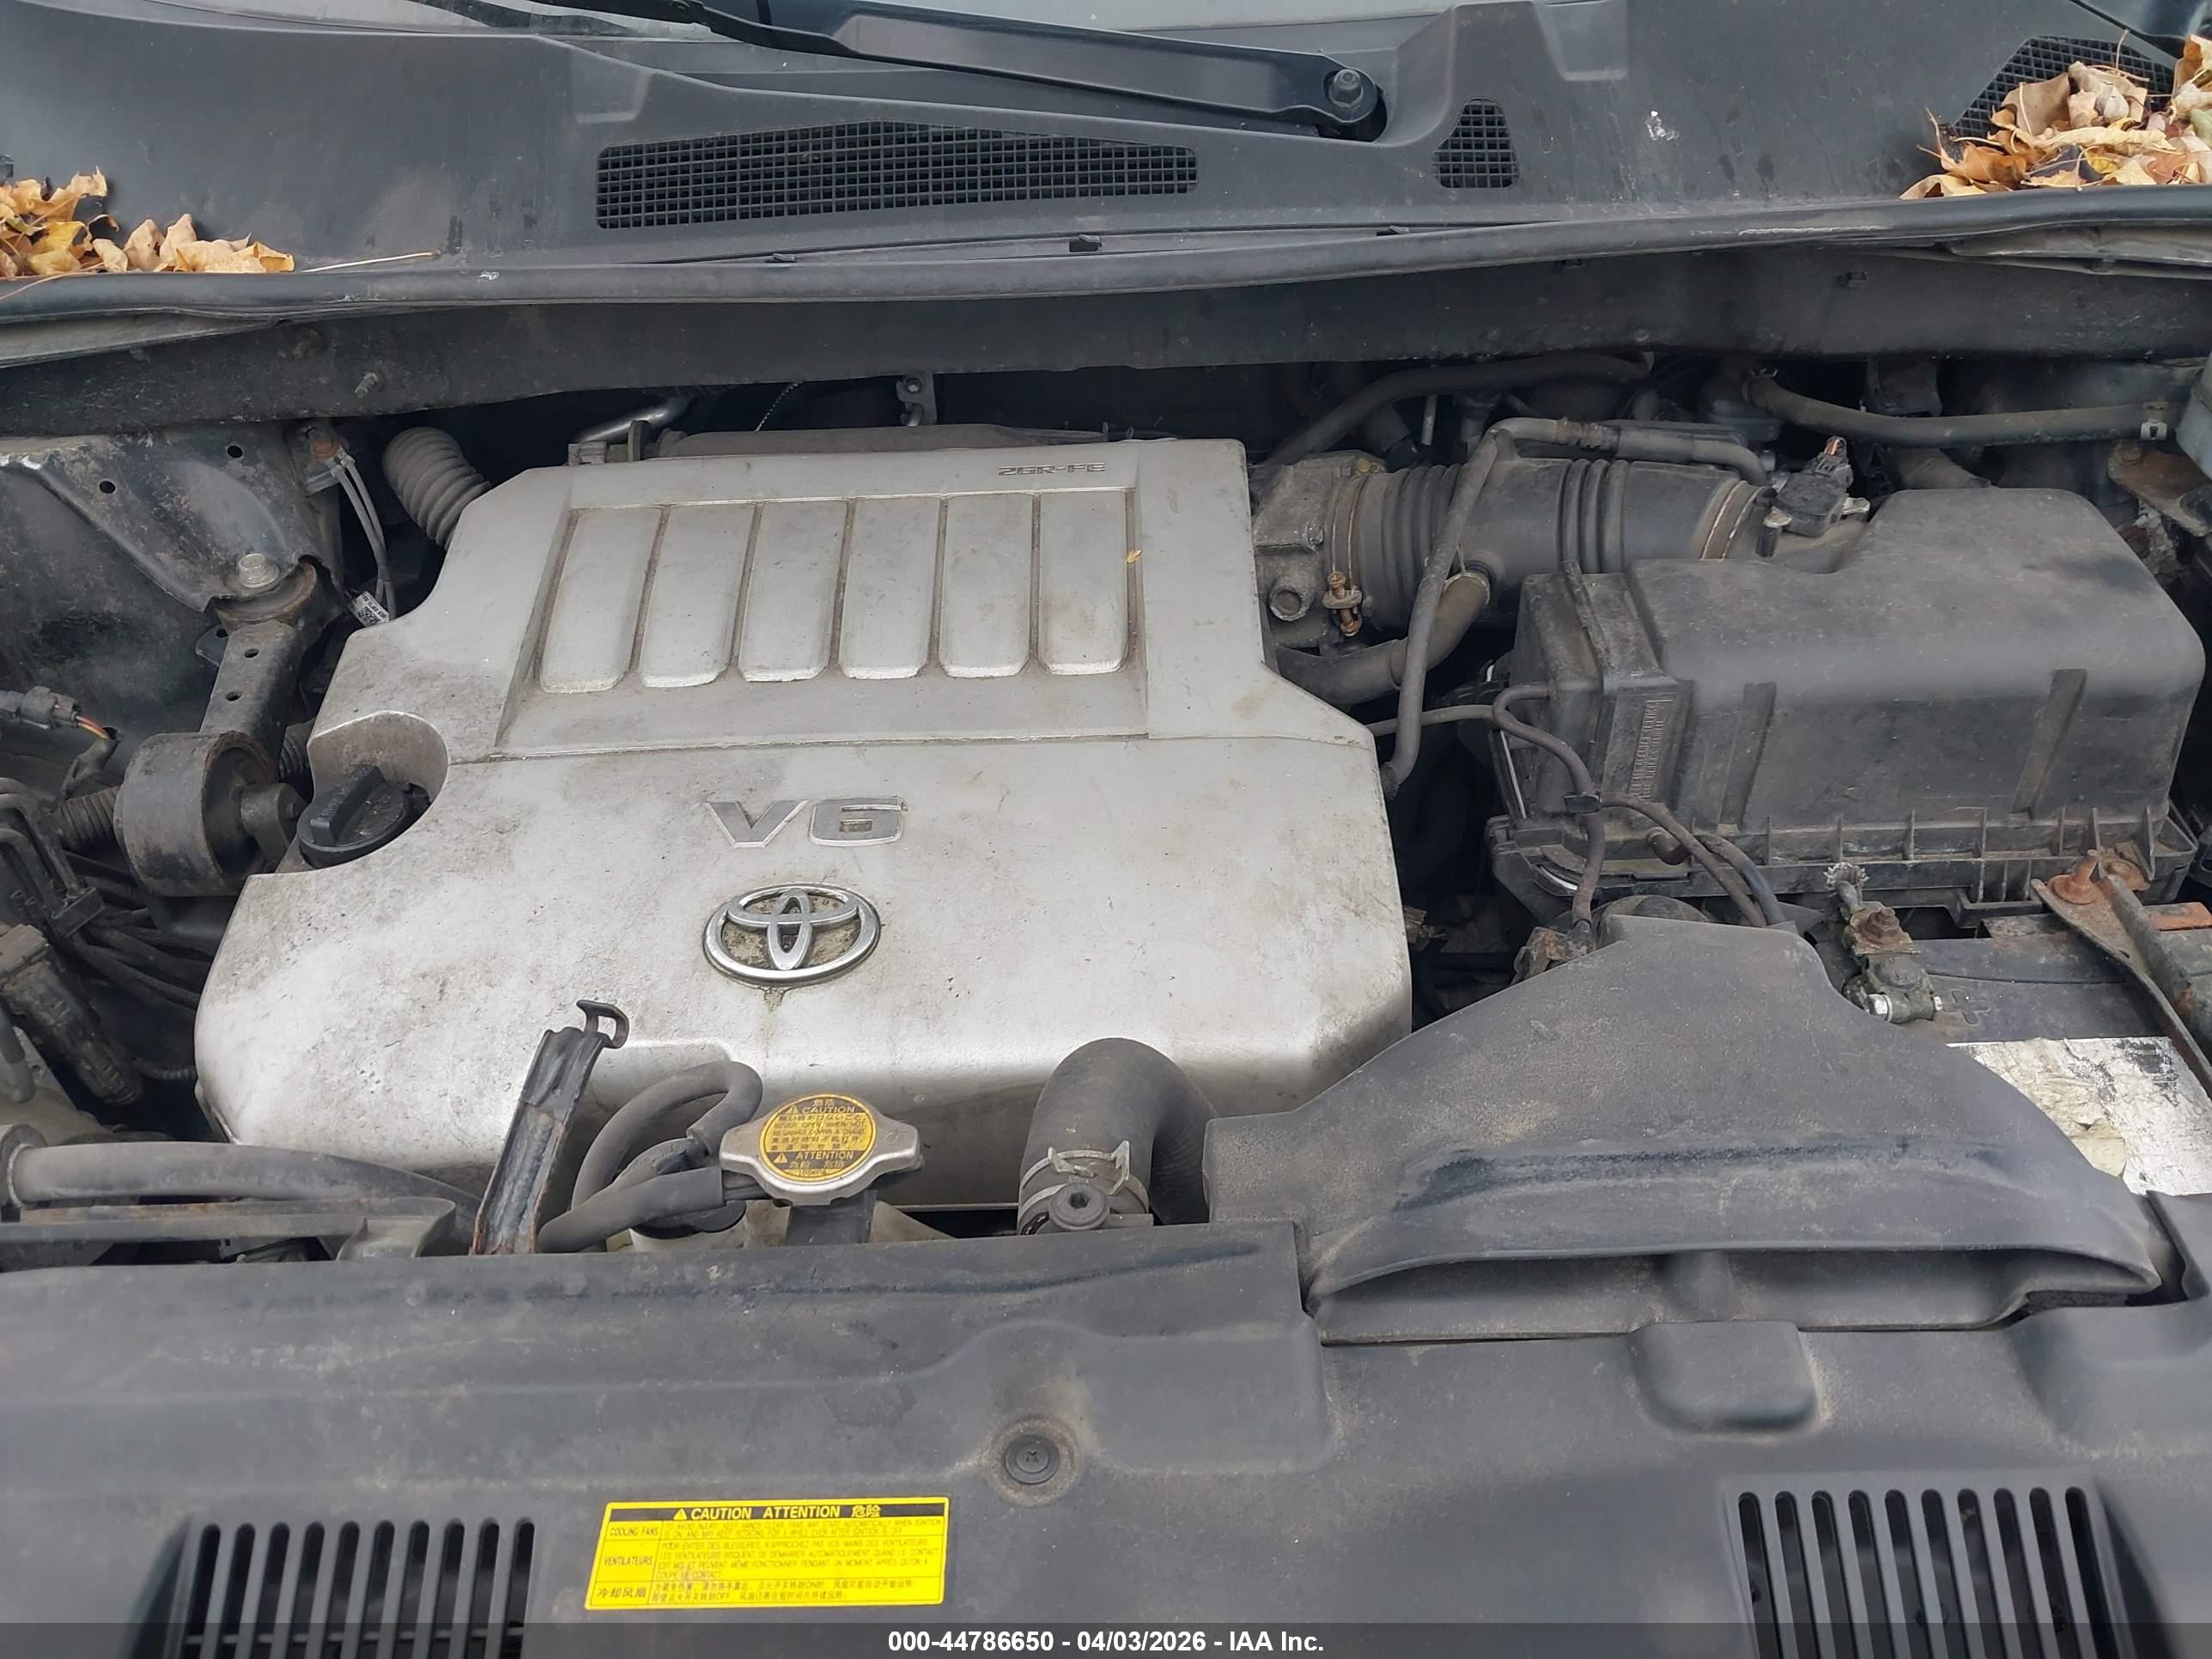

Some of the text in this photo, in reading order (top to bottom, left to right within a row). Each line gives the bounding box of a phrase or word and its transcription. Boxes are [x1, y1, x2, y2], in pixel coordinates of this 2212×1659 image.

[998, 462, 1106, 476] 2GR-FE
[705, 798, 903, 848] V6
[802, 1105, 855, 1114] CAUTION
[794, 1151, 854, 1161] ATTENTION
[690, 1507, 752, 1520] CAUTION
[763, 1505, 841, 1519] ATTENTION
[610, 1526, 659, 1536] COOLING FANS
[605, 1555, 653, 1566] VENTILATEURS
